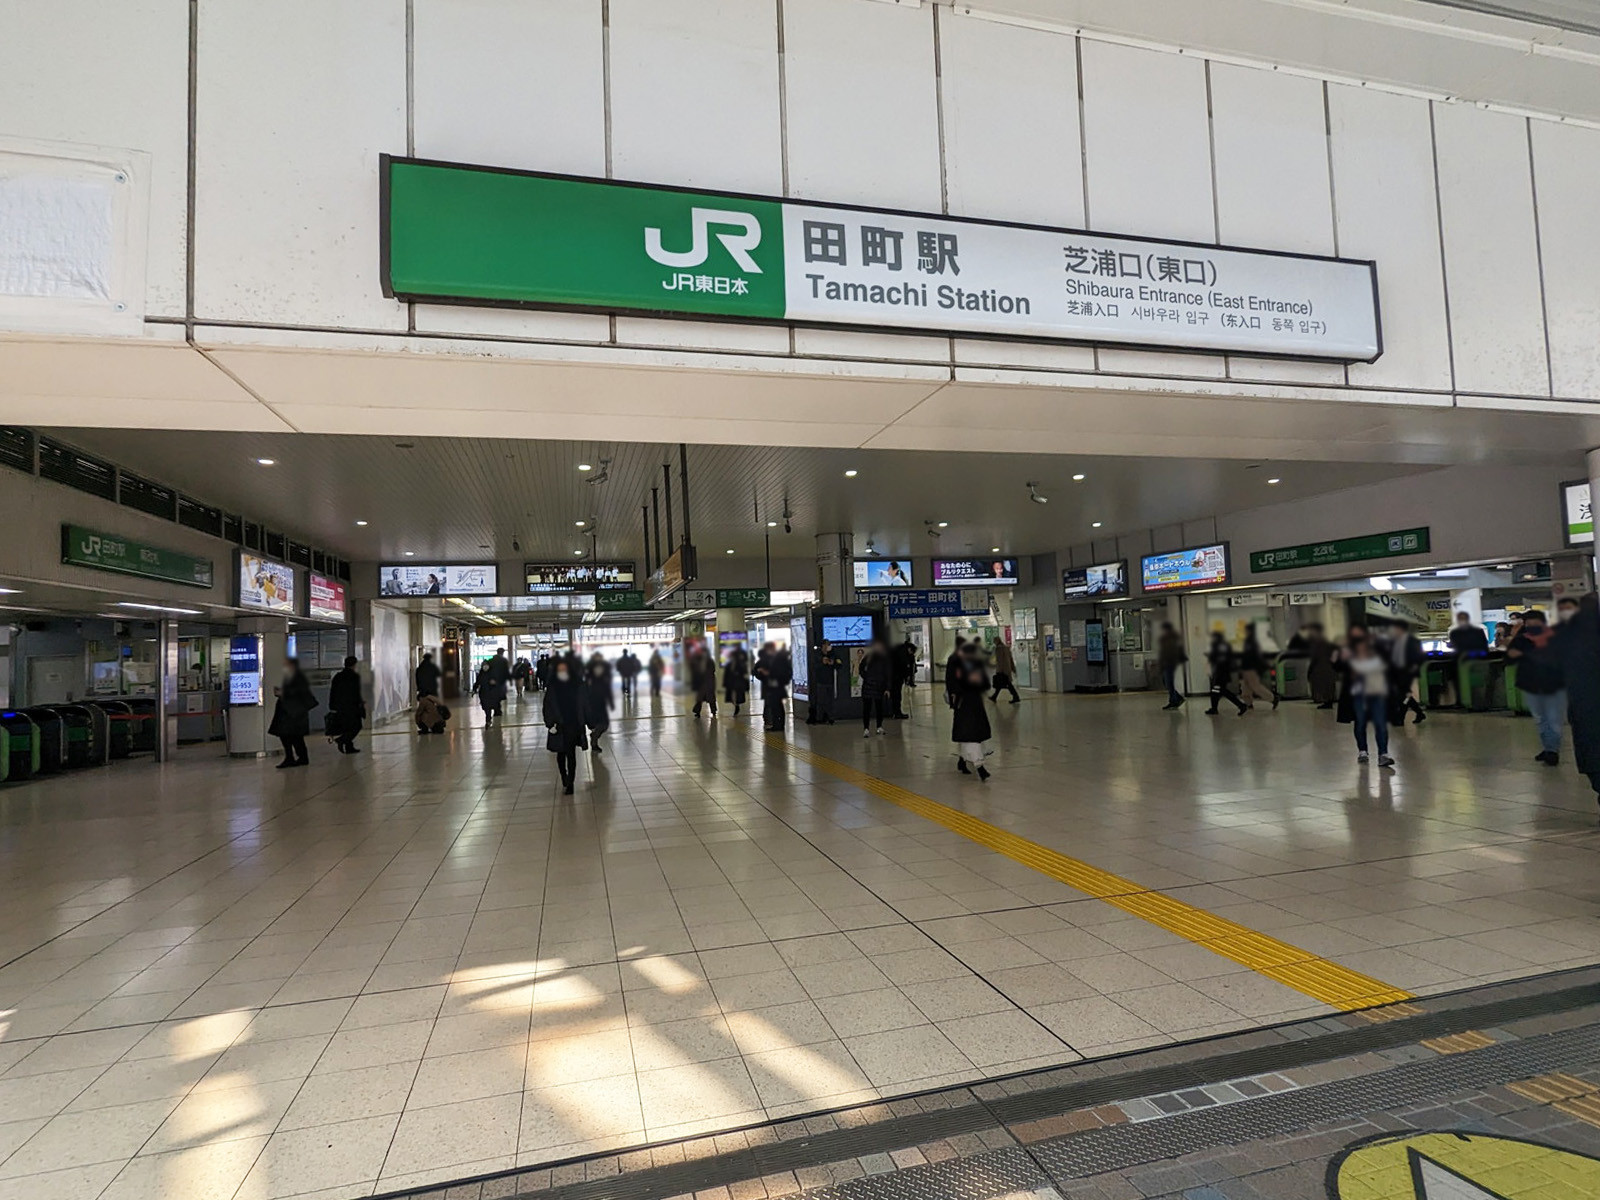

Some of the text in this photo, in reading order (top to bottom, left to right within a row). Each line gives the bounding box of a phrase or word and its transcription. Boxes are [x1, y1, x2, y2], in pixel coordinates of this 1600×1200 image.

[645, 207, 764, 274] JR
[803, 219, 961, 277] 田町駅
[1063, 245, 1217, 287] 芝浦口(東口)
[662, 272, 749, 296] JR東日本
[805, 273, 1031, 315] Tamachi Station
[1065, 278, 1313, 317] Shibaura Entrance (East Entrance)
[1067, 300, 1119, 318] 芝浦入口
[1131, 305, 1180, 323] 시바우라
[1185, 310, 1210, 326] 입구
[1271, 317, 1295, 332] 동쪽
[81, 535, 101, 556] JR
[1258, 553, 1275, 566] JR
[609, 593, 625, 602] JR
[743, 590, 757, 601] JR
[855, 592, 958, 605] 稲田アカデミー 田町校
